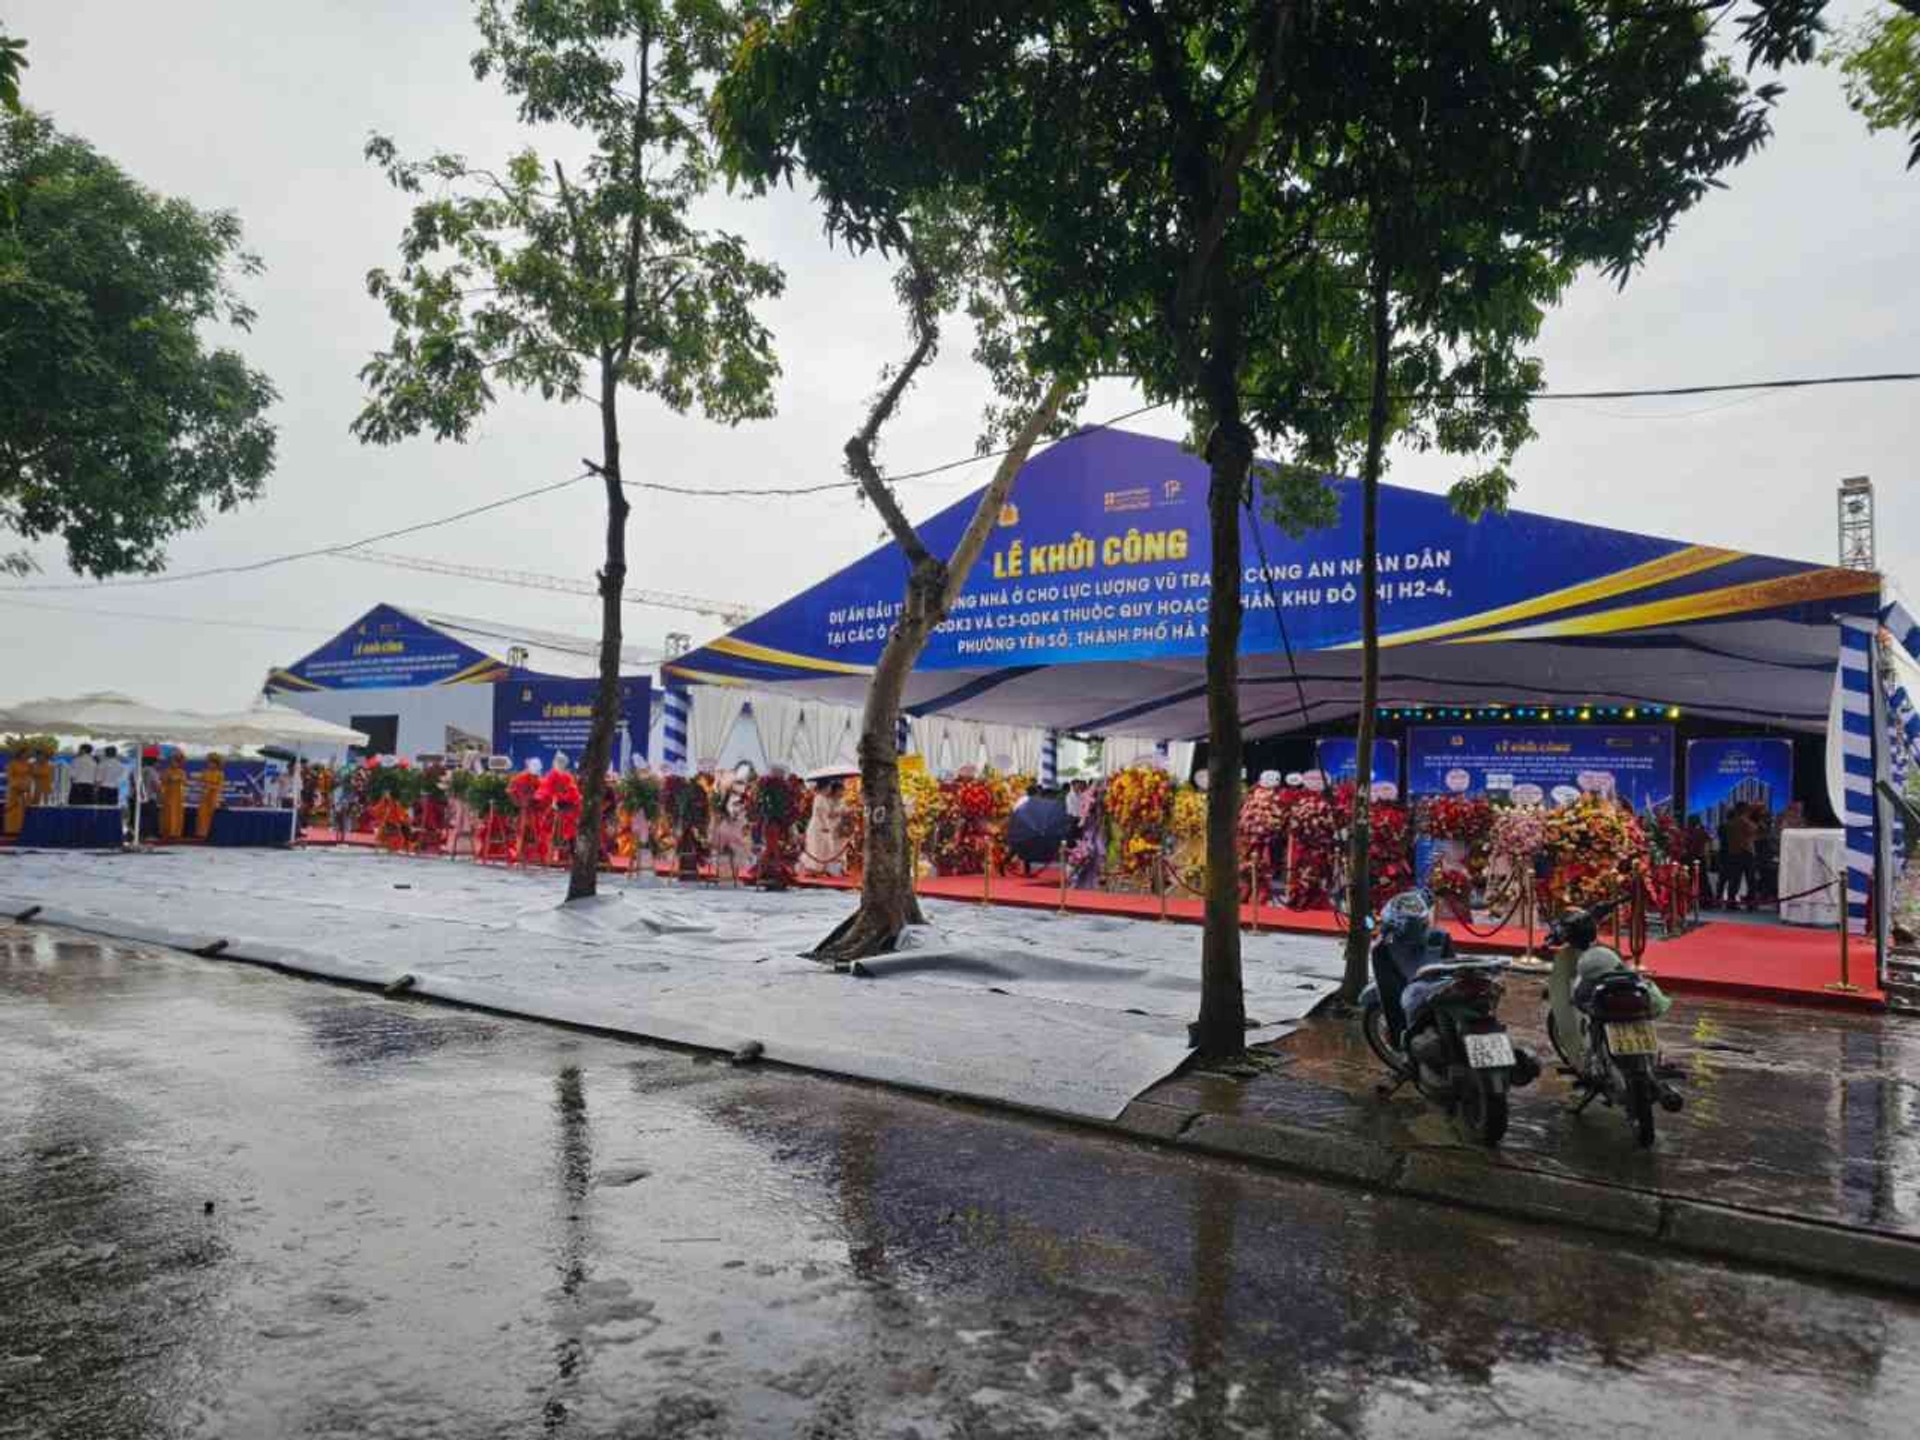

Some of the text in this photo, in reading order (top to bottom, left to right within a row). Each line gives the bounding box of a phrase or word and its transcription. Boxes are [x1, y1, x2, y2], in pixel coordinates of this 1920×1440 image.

[993, 527, 1188, 578] LỄ KHỞI CÔNG
[827, 628, 845, 650] TẠI
[847, 625, 875, 643] CÁC
[974, 612, 994, 630] VÀ
[996, 609, 1059, 629] C3-ODK4
[1120, 601, 1152, 619] QUY
[1157, 597, 1210, 619] HOẠC
[1282, 587, 1322, 607] KHU
[1326, 581, 1357, 604] ĐÔ
[1398, 578, 1453, 601] H2-4,
[829, 608, 846, 627] DỰ
[848, 605, 865, 622] ÁN
[980, 587, 1008, 609] NHÀ
[1026, 586, 1059, 604] CHO
[1063, 583, 1092, 607] LỰC
[1095, 576, 1151, 600] LƯỢNG
[1154, 573, 1177, 591] VŨ
[1308, 560, 1335, 578] AN
[1404, 547, 1452, 570] DÂN
[958, 634, 1016, 654] PHƯỜNG
[1020, 631, 1045, 650] YÊN
[1077, 626, 1129, 646] THÀNH
[1133, 619, 1168, 641] PHỐ
[1172, 619, 1196, 639] HÀ
